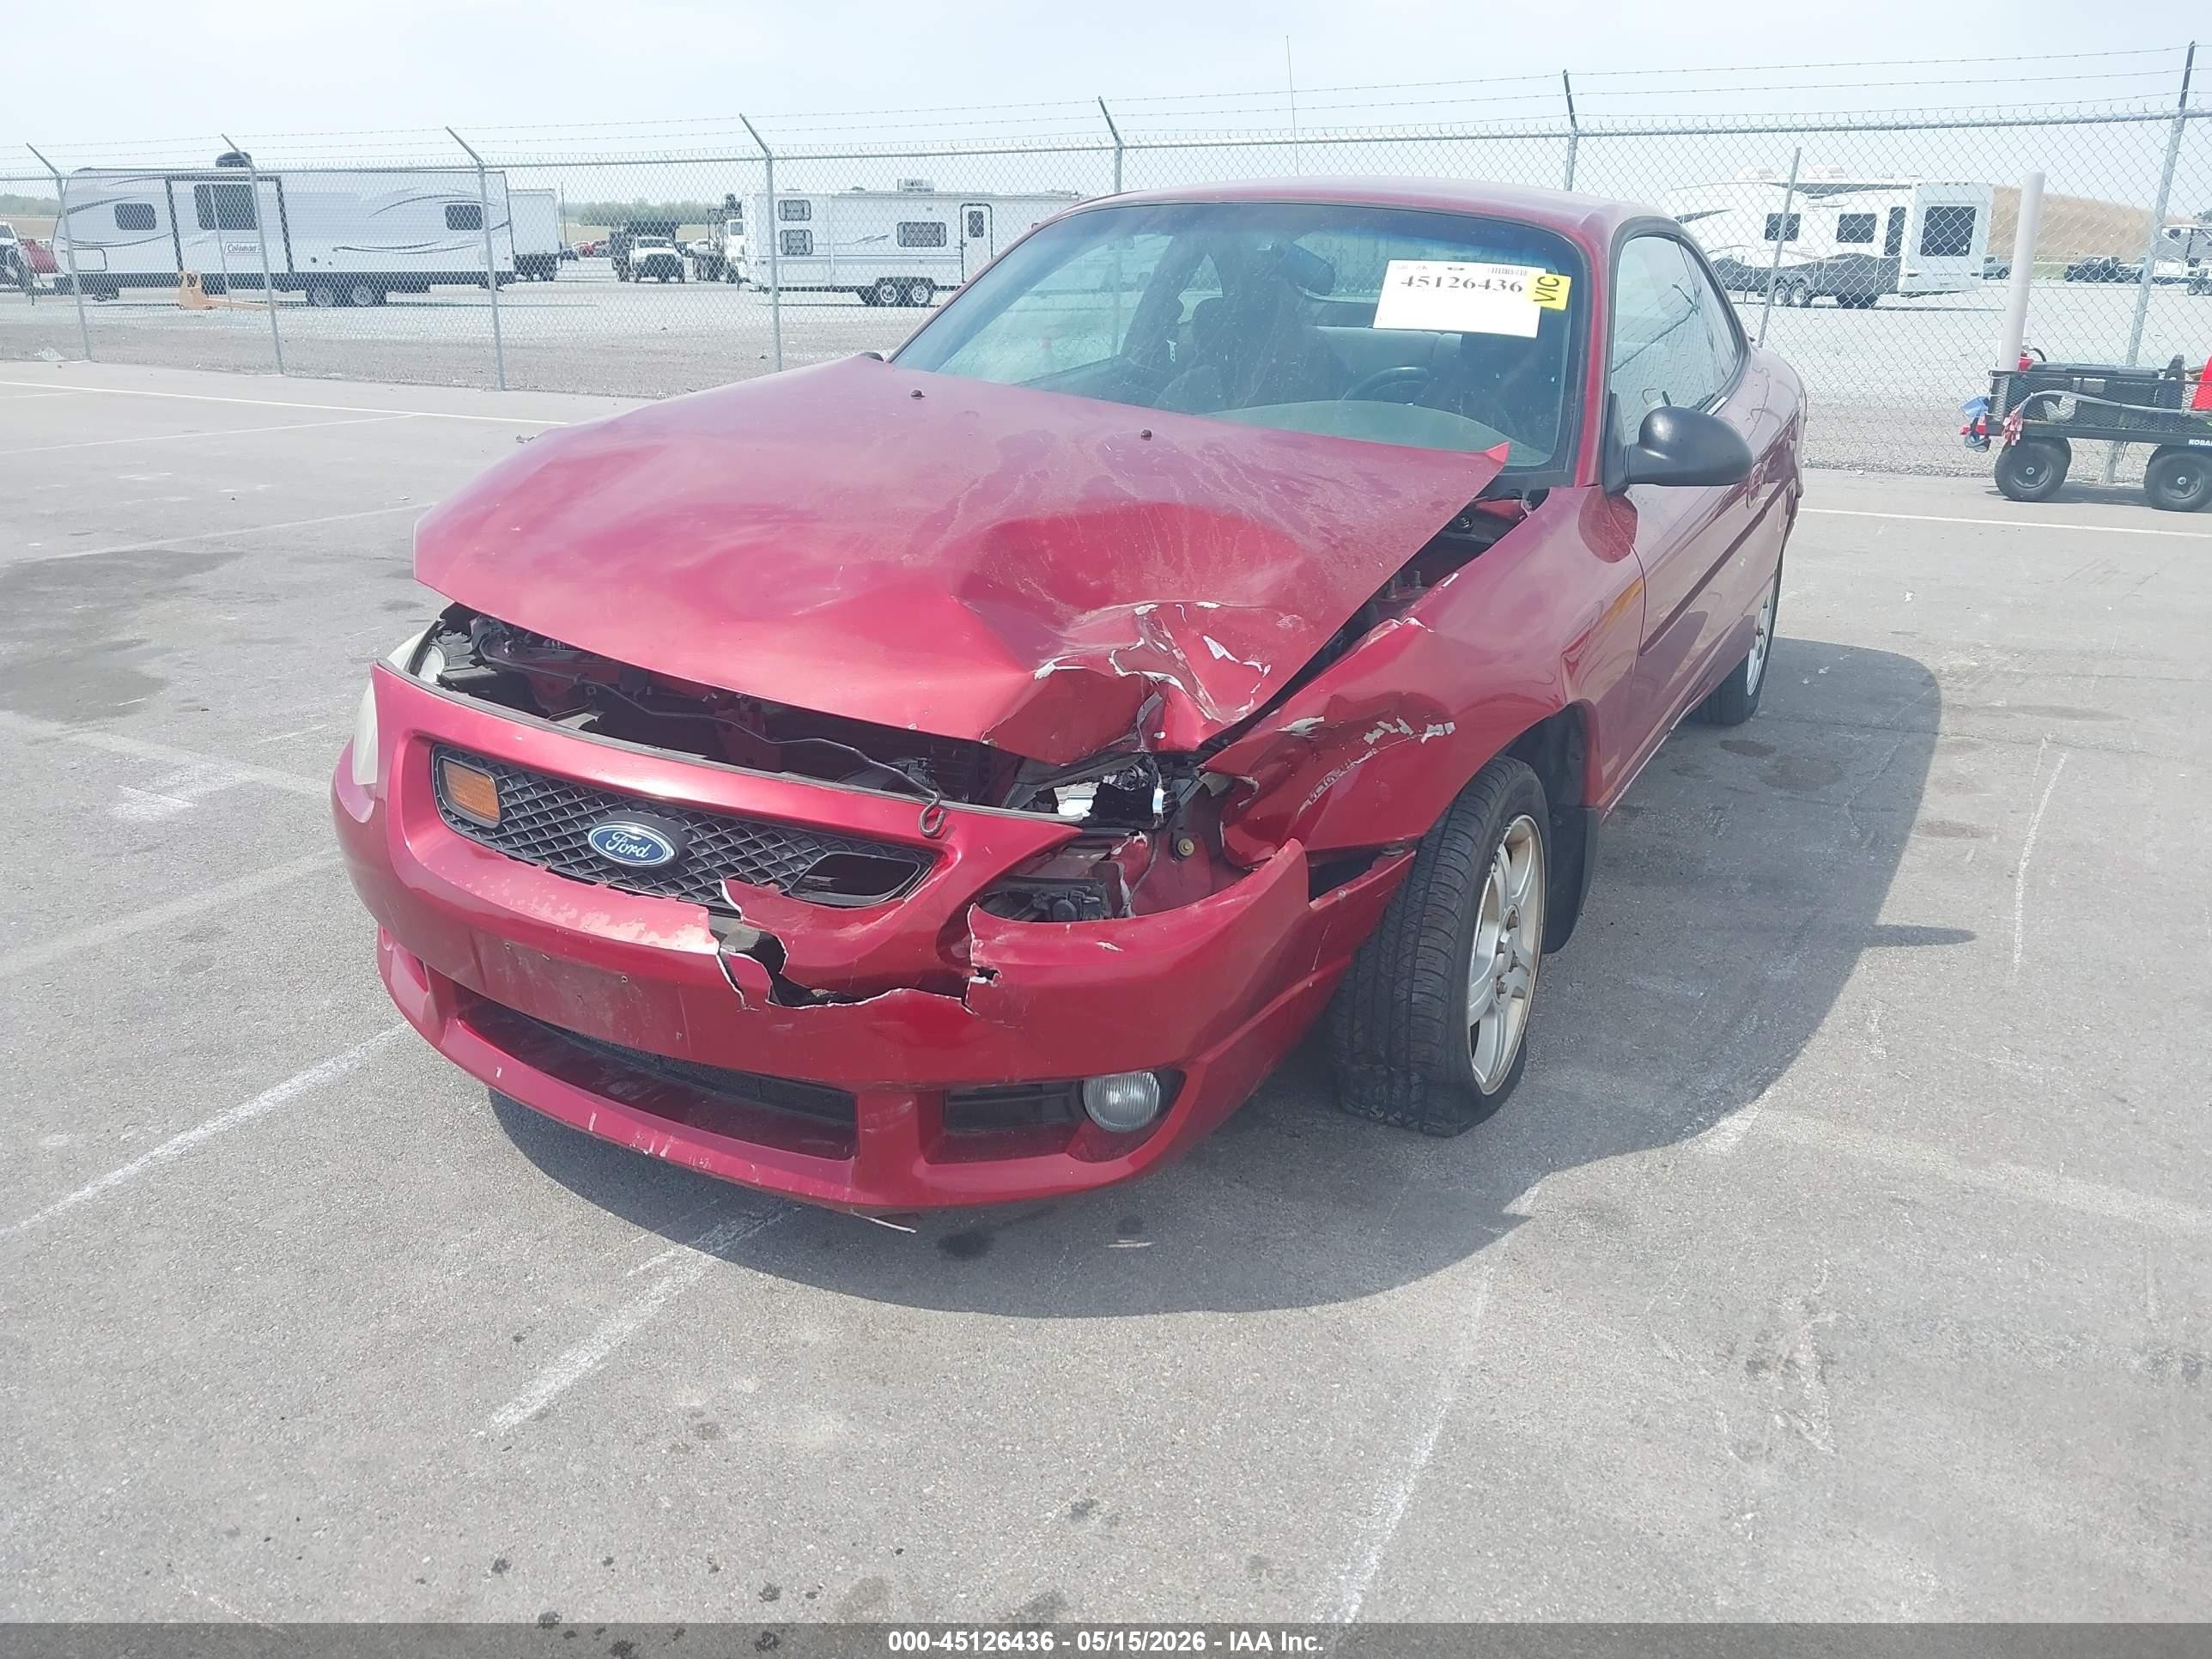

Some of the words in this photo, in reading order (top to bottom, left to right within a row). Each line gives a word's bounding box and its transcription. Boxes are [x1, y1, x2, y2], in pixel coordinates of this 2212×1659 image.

[227, 243, 257, 252] Coleman
[1401, 275, 1523, 293] 45126436
[1533, 276, 1560, 302] VIC
[605, 831, 652, 858] Ford
